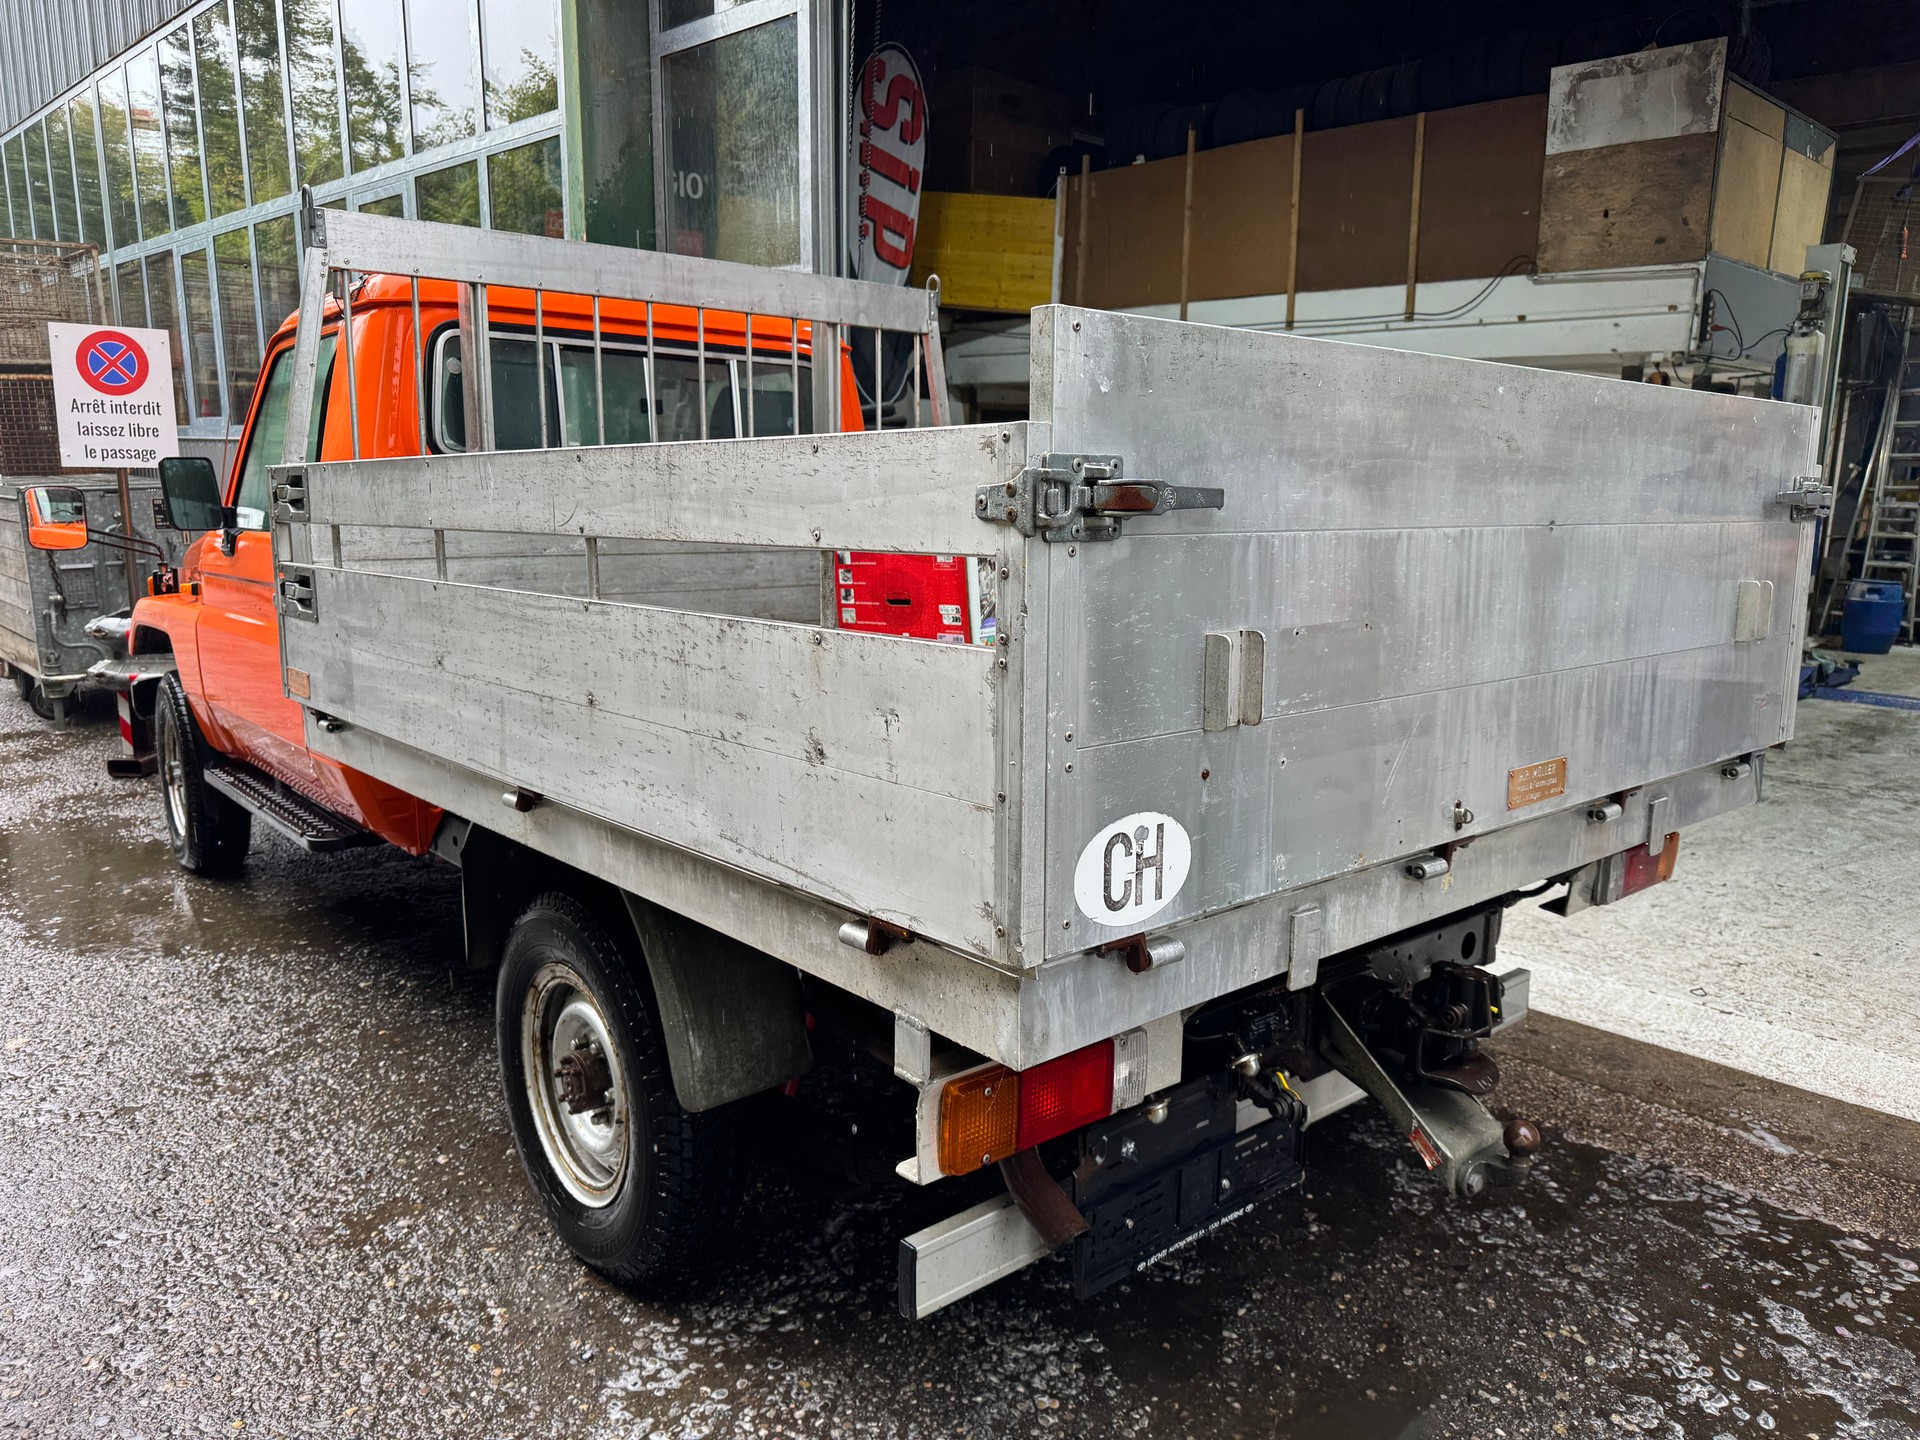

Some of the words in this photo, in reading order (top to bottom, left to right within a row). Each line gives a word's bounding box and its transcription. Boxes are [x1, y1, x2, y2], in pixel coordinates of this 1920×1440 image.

[70, 398, 107, 414] Arrêt
[110, 400, 162, 416] interdit
[77, 421, 125, 437] laissez
[128, 422, 160, 438] libre
[84, 444, 97, 459] le
[101, 447, 157, 463] passage
[1103, 823, 1164, 912] CH
